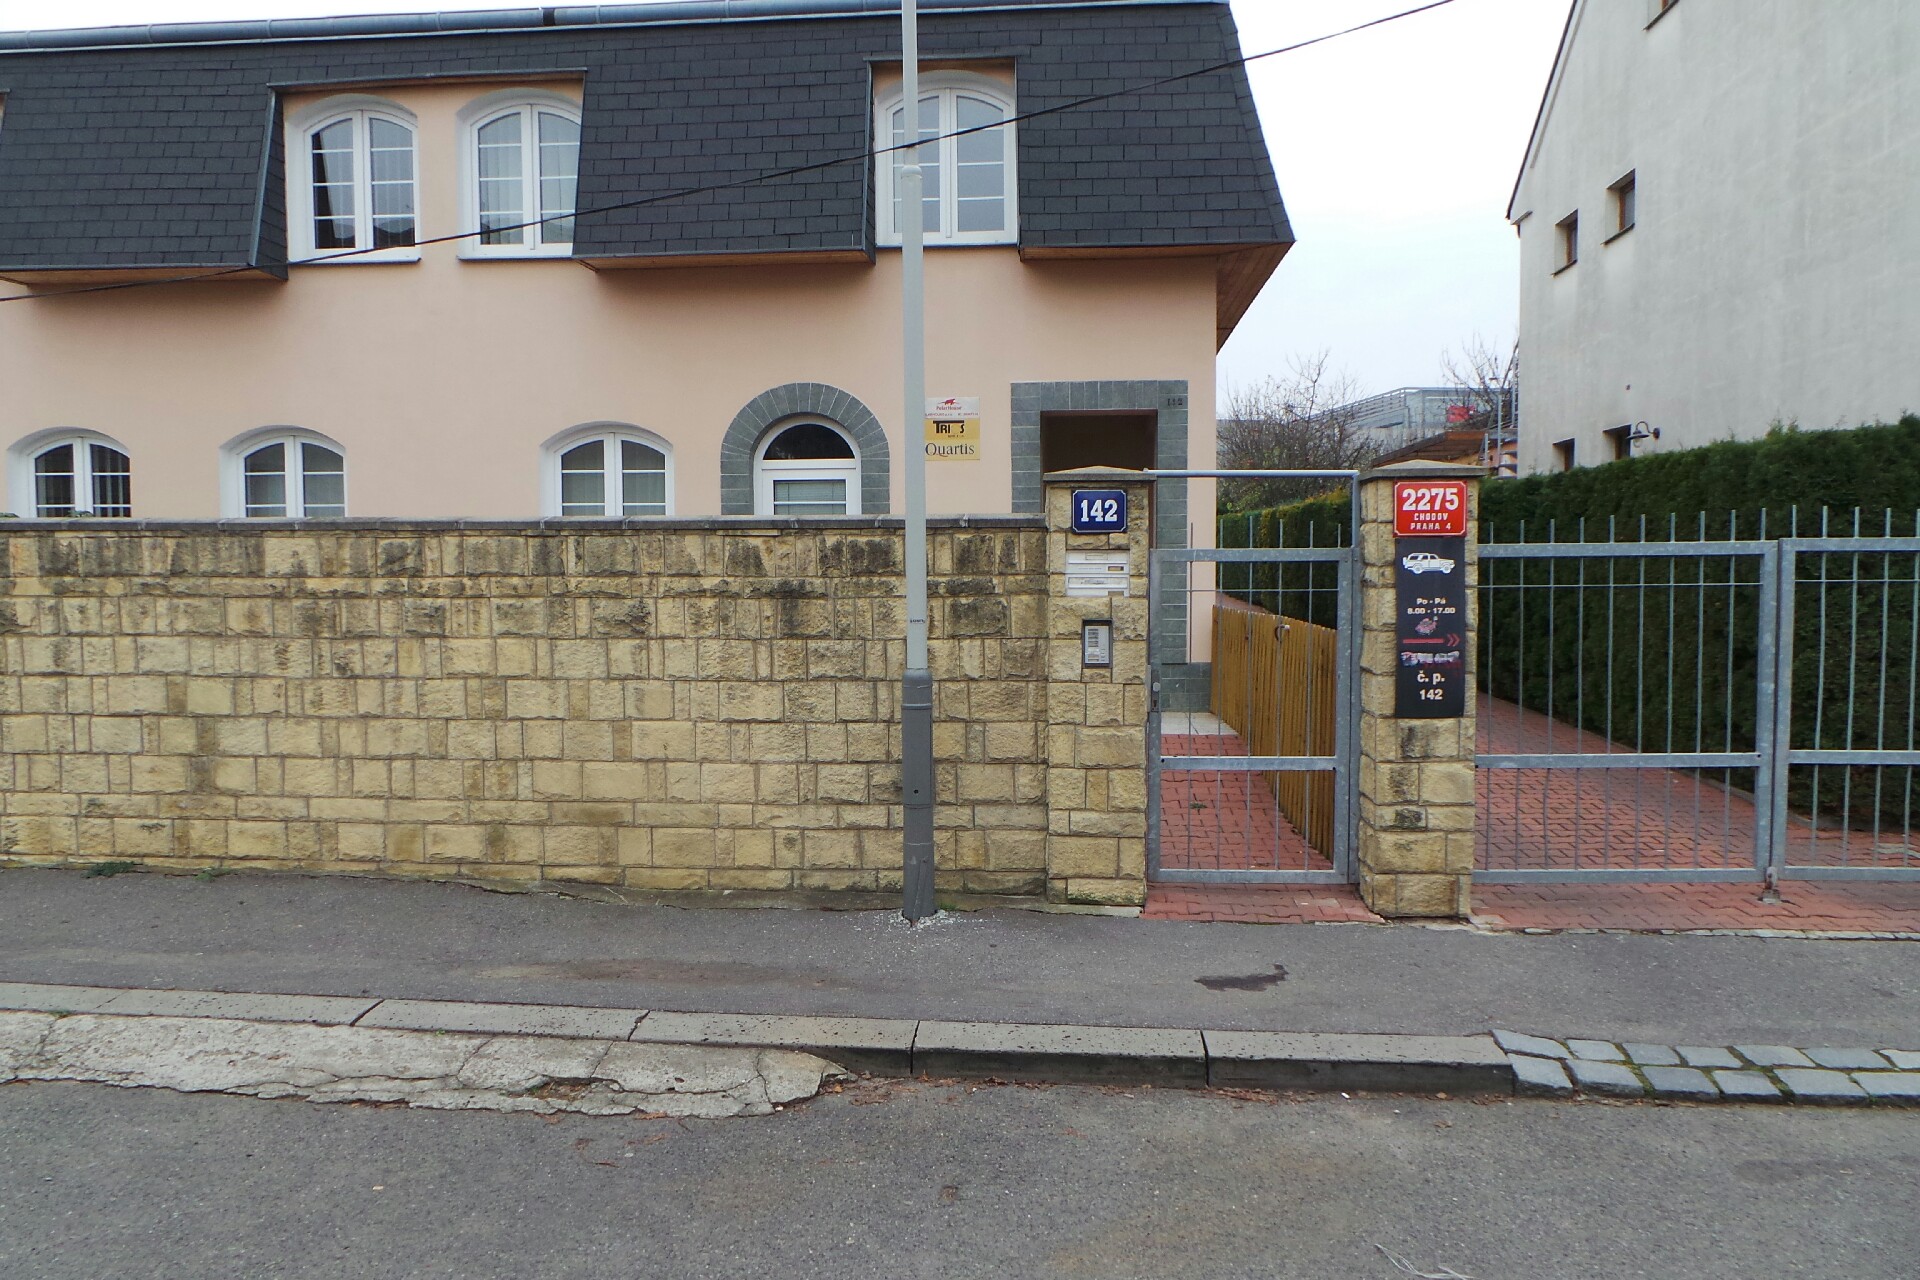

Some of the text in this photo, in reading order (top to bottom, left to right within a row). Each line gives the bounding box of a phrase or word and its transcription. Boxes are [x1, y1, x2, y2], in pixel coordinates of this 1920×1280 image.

[925, 442, 975, 457] Quartis
[1402, 487, 1459, 511] 2275
[1080, 499, 1118, 522] 142
[1414, 512, 1448, 521] CHODOV
[1410, 522, 1452, 530] PRAHA 4
[1416, 597, 1428, 605] Po
[1417, 670, 1446, 685] č. p.
[1419, 689, 1443, 700] 142
